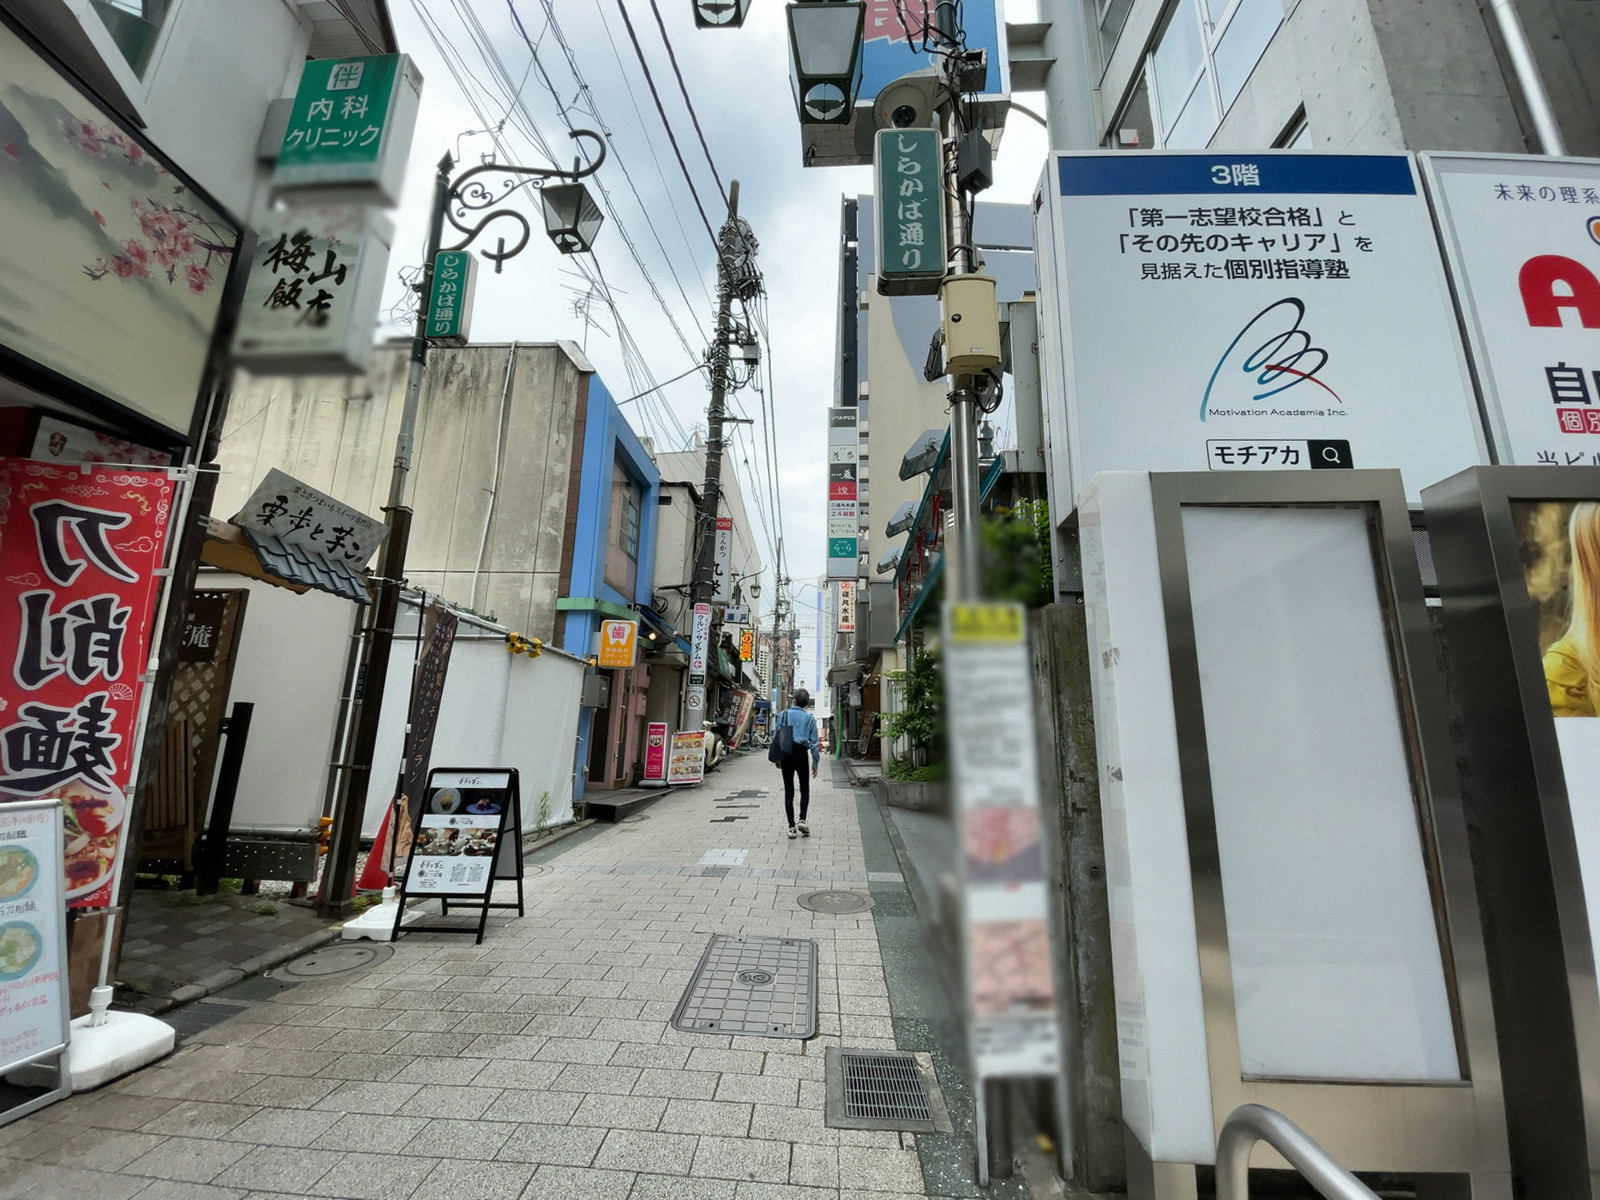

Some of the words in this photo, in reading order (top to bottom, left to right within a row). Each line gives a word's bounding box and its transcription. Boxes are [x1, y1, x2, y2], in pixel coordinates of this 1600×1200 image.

[333, 65, 360, 88] 伴
[307, 95, 368, 122] 内科
[287, 125, 380, 148] クリニック
[1211, 164, 1260, 187] 3階
[896, 133, 927, 270] しらかば通り
[1494, 183, 1600, 204] 未来の理系
[1140, 258, 1350, 281] 見据えた個別指導塾
[433, 254, 460, 335] しらかば通り
[1544, 362, 1600, 405] 自
[1209, 407, 1267, 417] Motivation
[1270, 407, 1325, 417] Academia
[1328, 408, 1349, 417] Inc.
[1214, 446, 1300, 467] モチアカ
